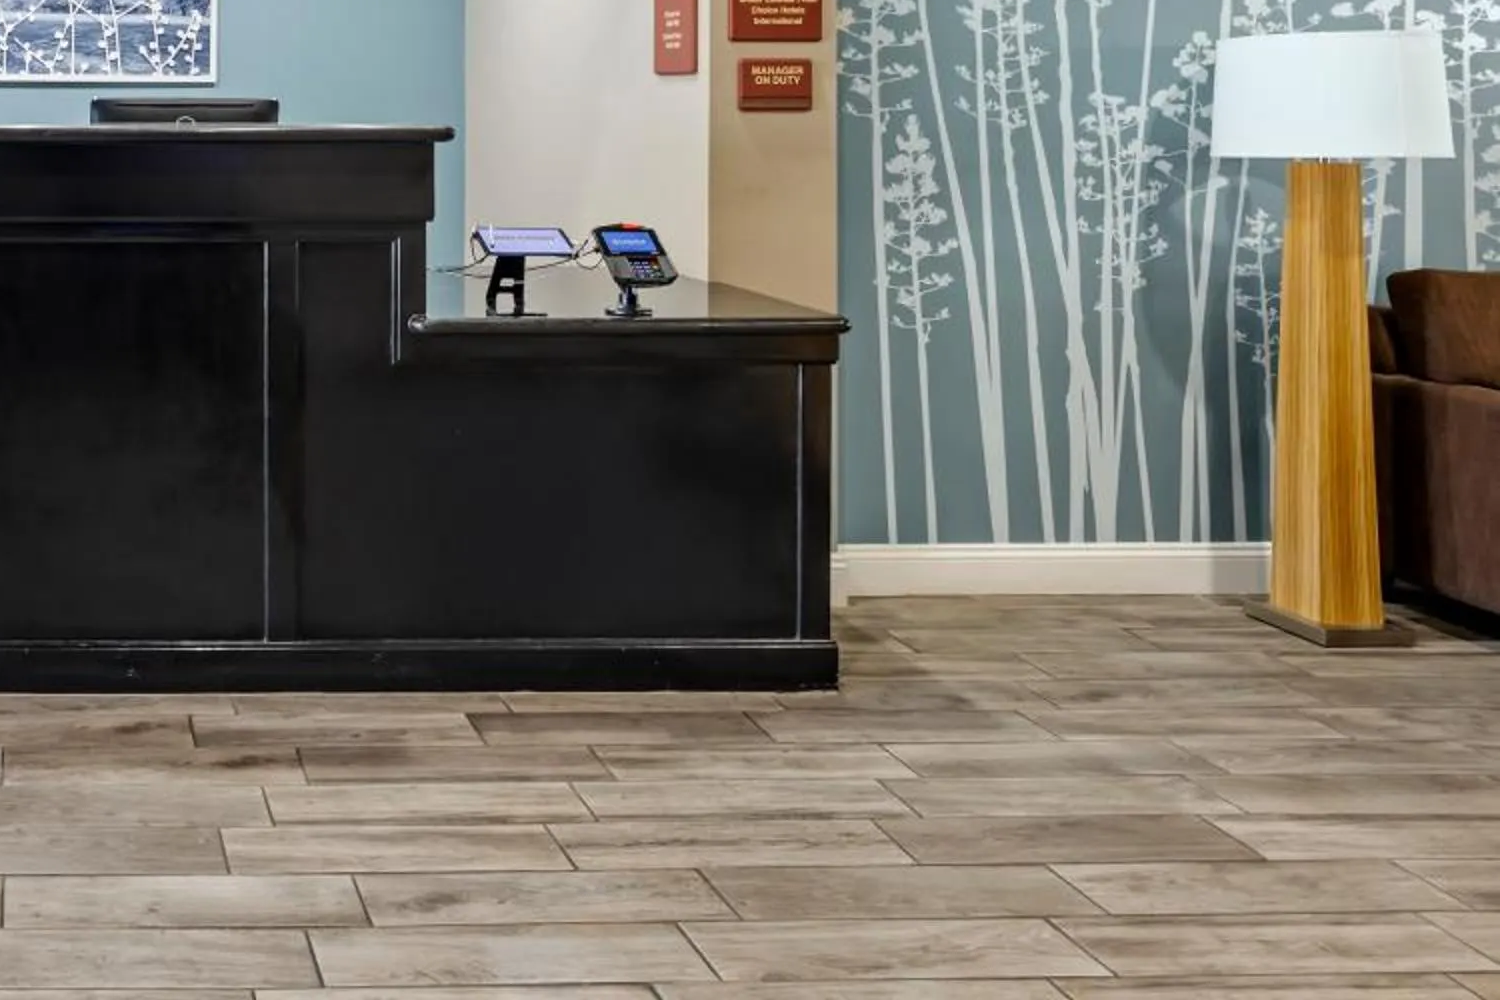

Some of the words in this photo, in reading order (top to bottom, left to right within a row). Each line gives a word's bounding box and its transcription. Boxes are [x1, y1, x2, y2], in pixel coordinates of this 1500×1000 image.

[751, 65, 804, 75] MANAGER
[755, 75, 771, 85] ON
[772, 75, 801, 85] DUTY
